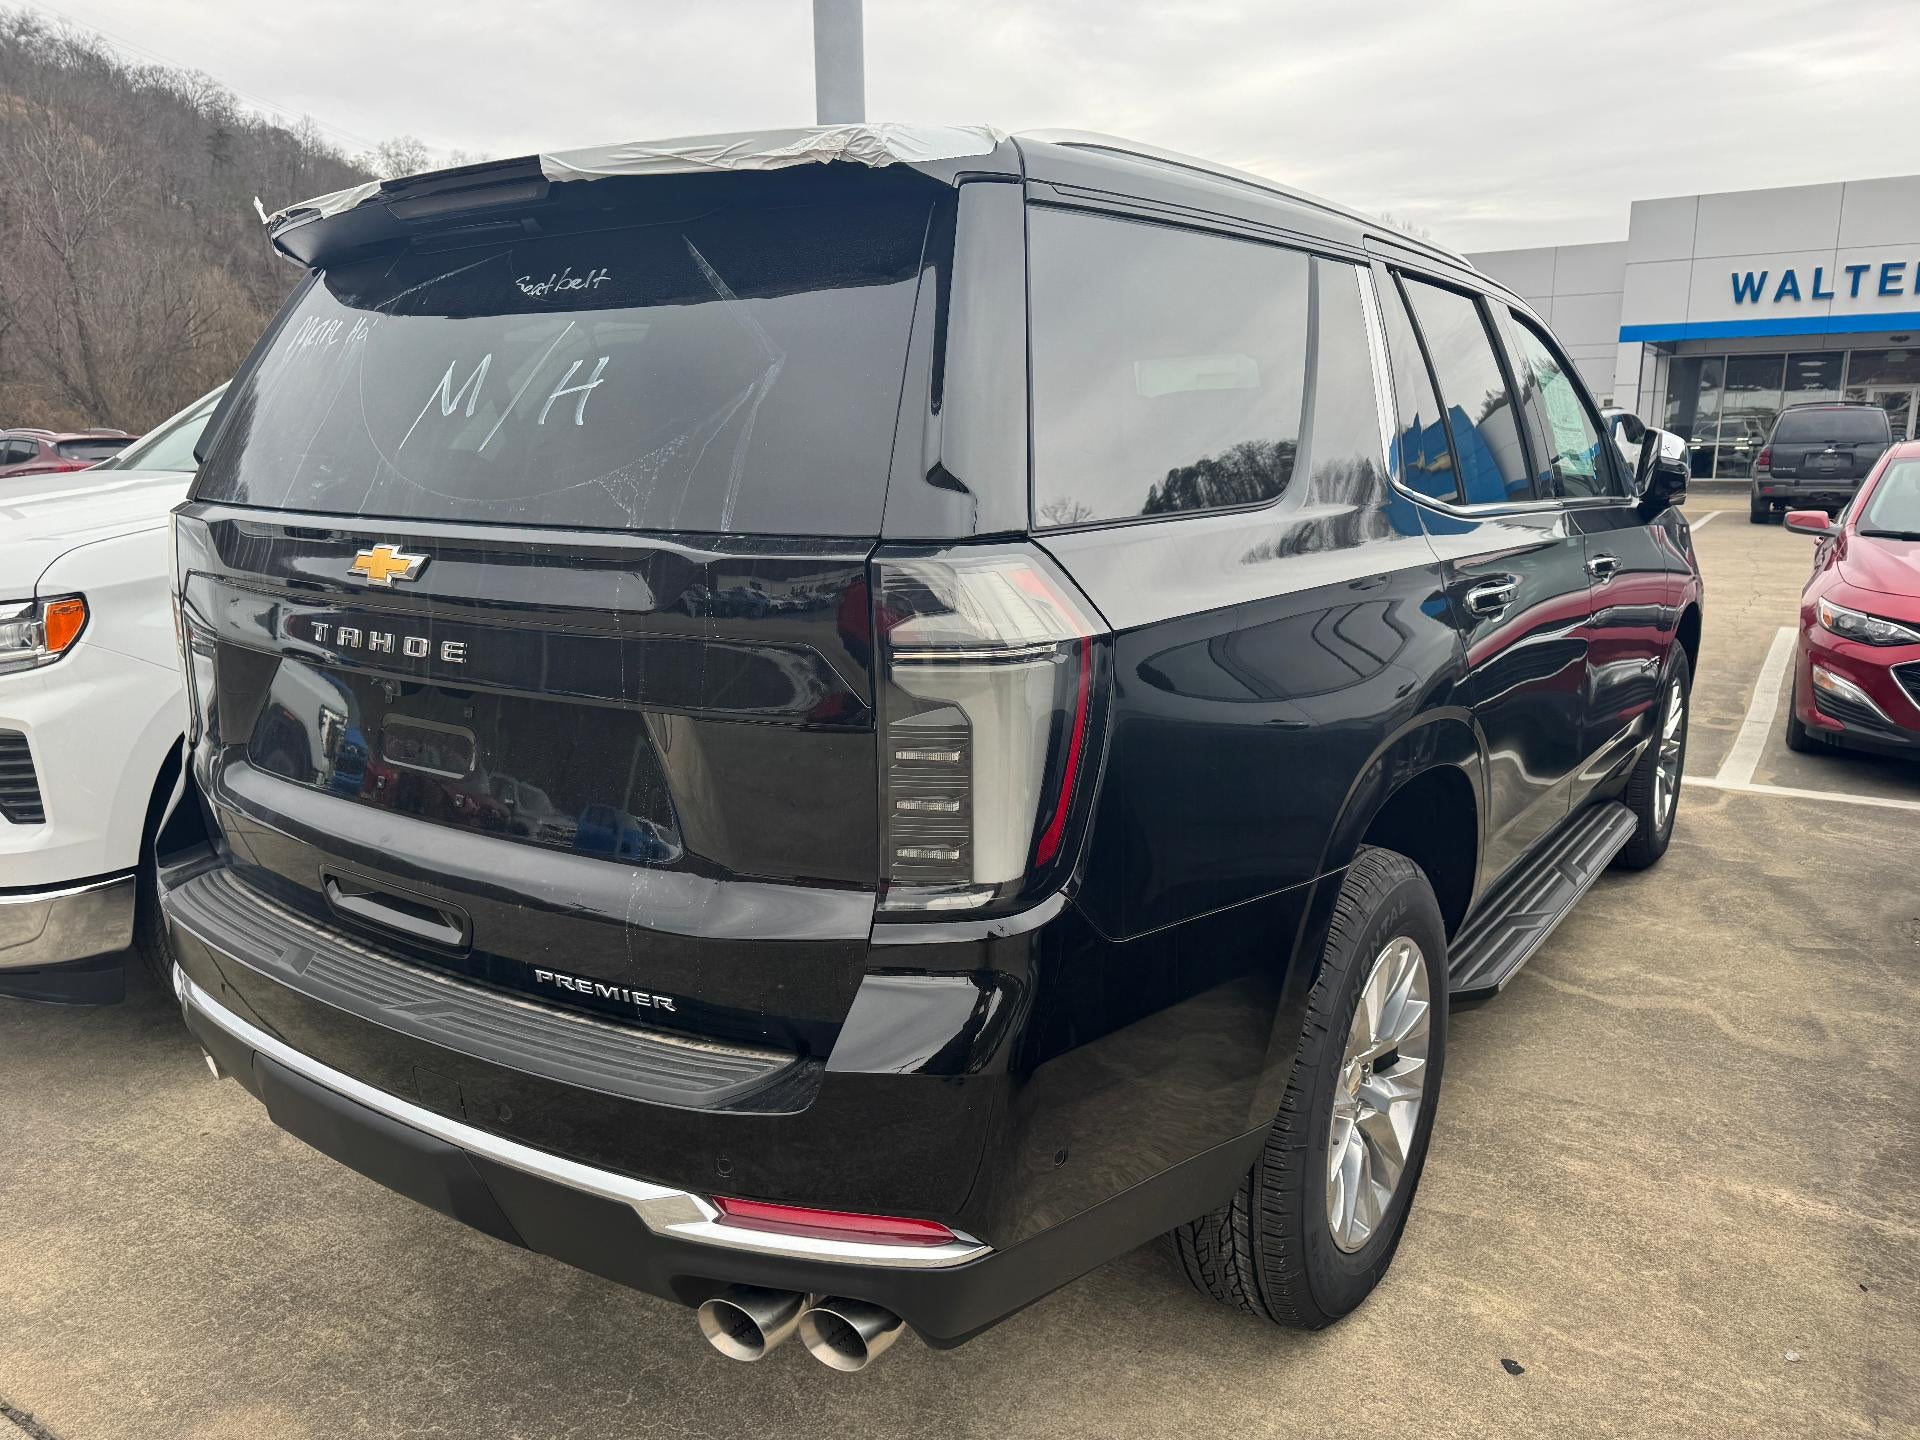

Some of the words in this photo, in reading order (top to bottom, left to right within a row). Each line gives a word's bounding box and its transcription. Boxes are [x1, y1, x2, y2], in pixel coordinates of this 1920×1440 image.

[1731, 261, 1920, 304] WALTE
[311, 621, 467, 664] TAHOE
[535, 969, 677, 1012] PREMIER
